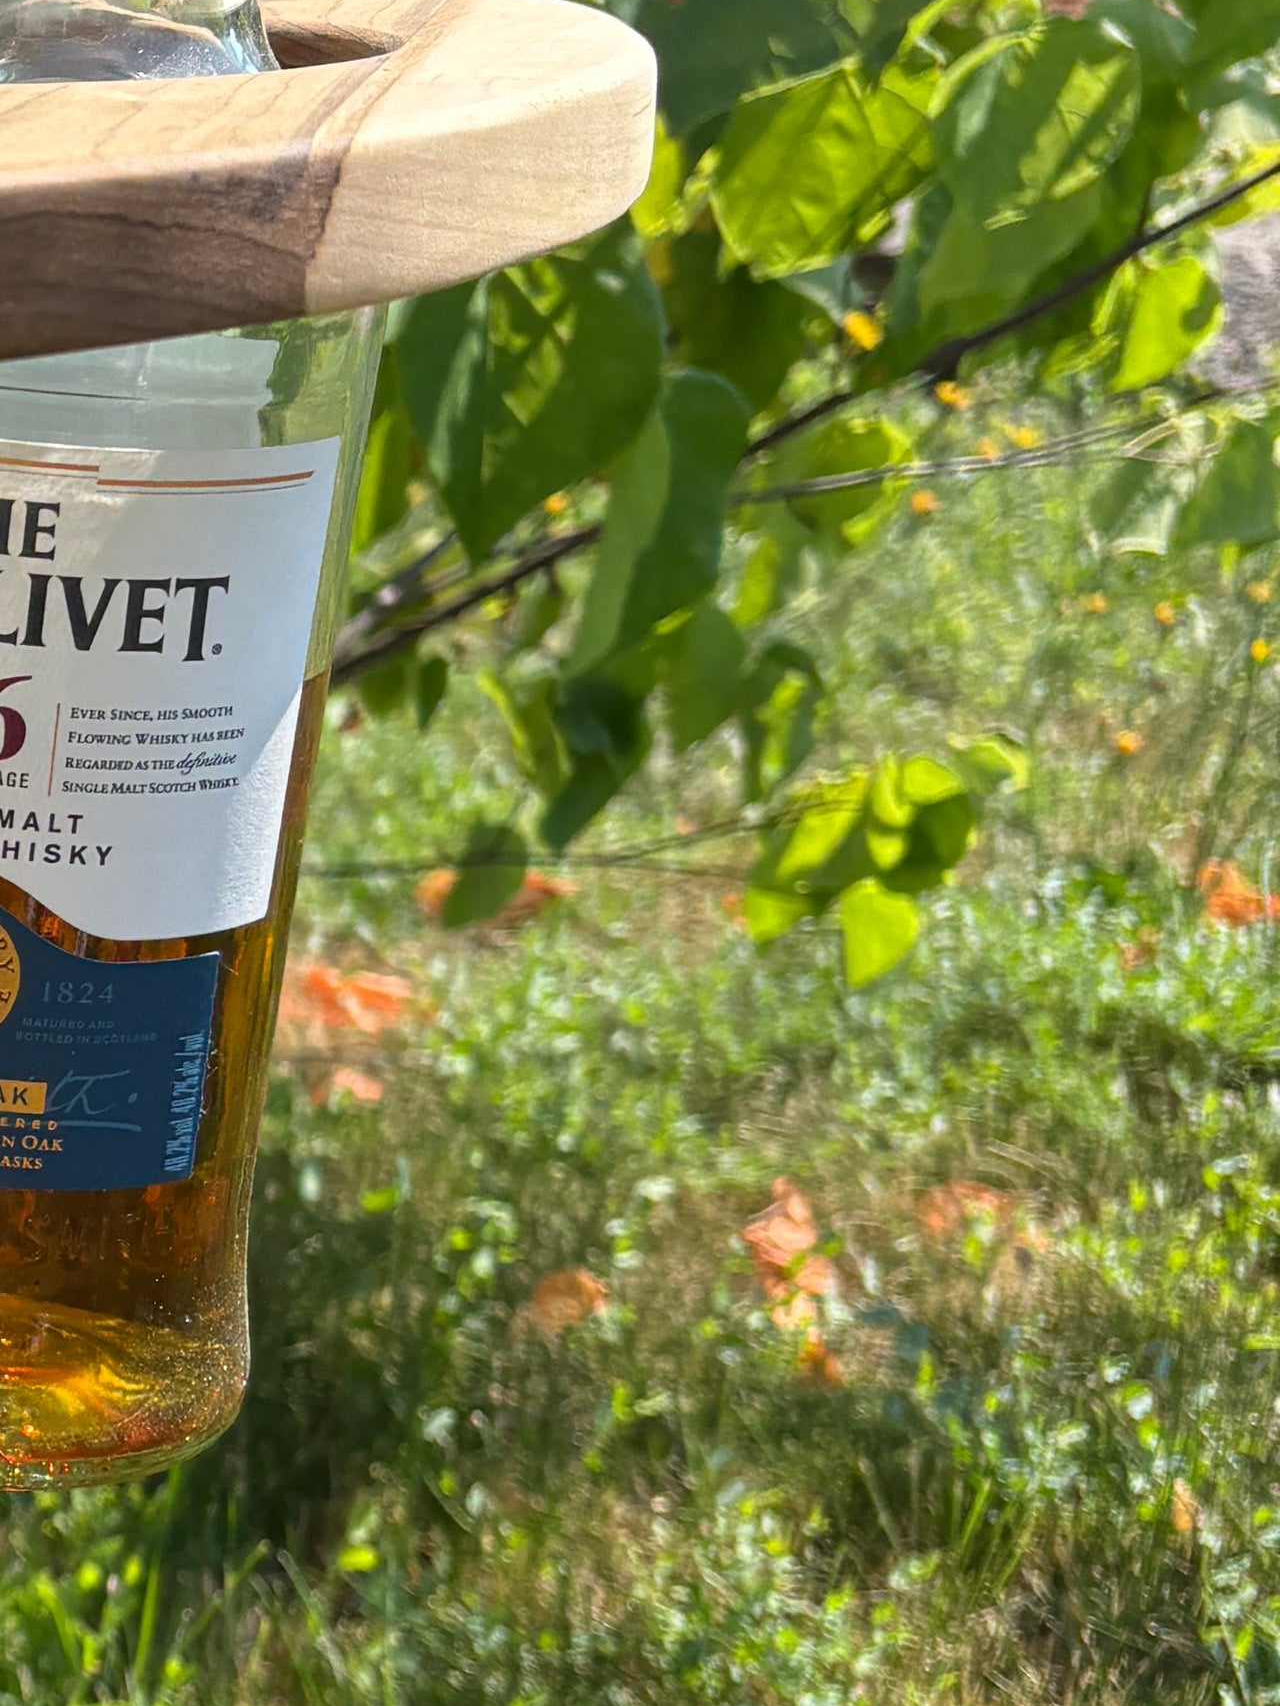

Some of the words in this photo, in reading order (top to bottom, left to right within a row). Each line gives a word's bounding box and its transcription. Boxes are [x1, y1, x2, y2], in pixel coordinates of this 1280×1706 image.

[70, 707, 106, 720] EVER
[110, 708, 154, 722] SINCE,
[157, 709, 178, 721] HIS
[181, 706, 233, 720] SMOOTH
[67, 731, 132, 745] FLOWING
[135, 733, 189, 745] WHISKY
[191, 730, 215, 743] HAS
[216, 728, 245, 741] BEEN
[65, 756, 133, 770] REGARDED
[134, 759, 150, 771] AS
[151, 759, 176, 770] THE
[176, 751, 237, 775] definitive
[62, 781, 109, 794] SINGLE
[110, 782, 148, 794] MALT
[149, 781, 196, 794] SCOTCH
[41, 980, 115, 1005] 1824
[22, 1017, 86, 1030] MATURED
[89, 1019, 115, 1030] AND
[16, 1030, 75, 1045] BOTTLED
[21, 1135, 64, 1152] OAK
